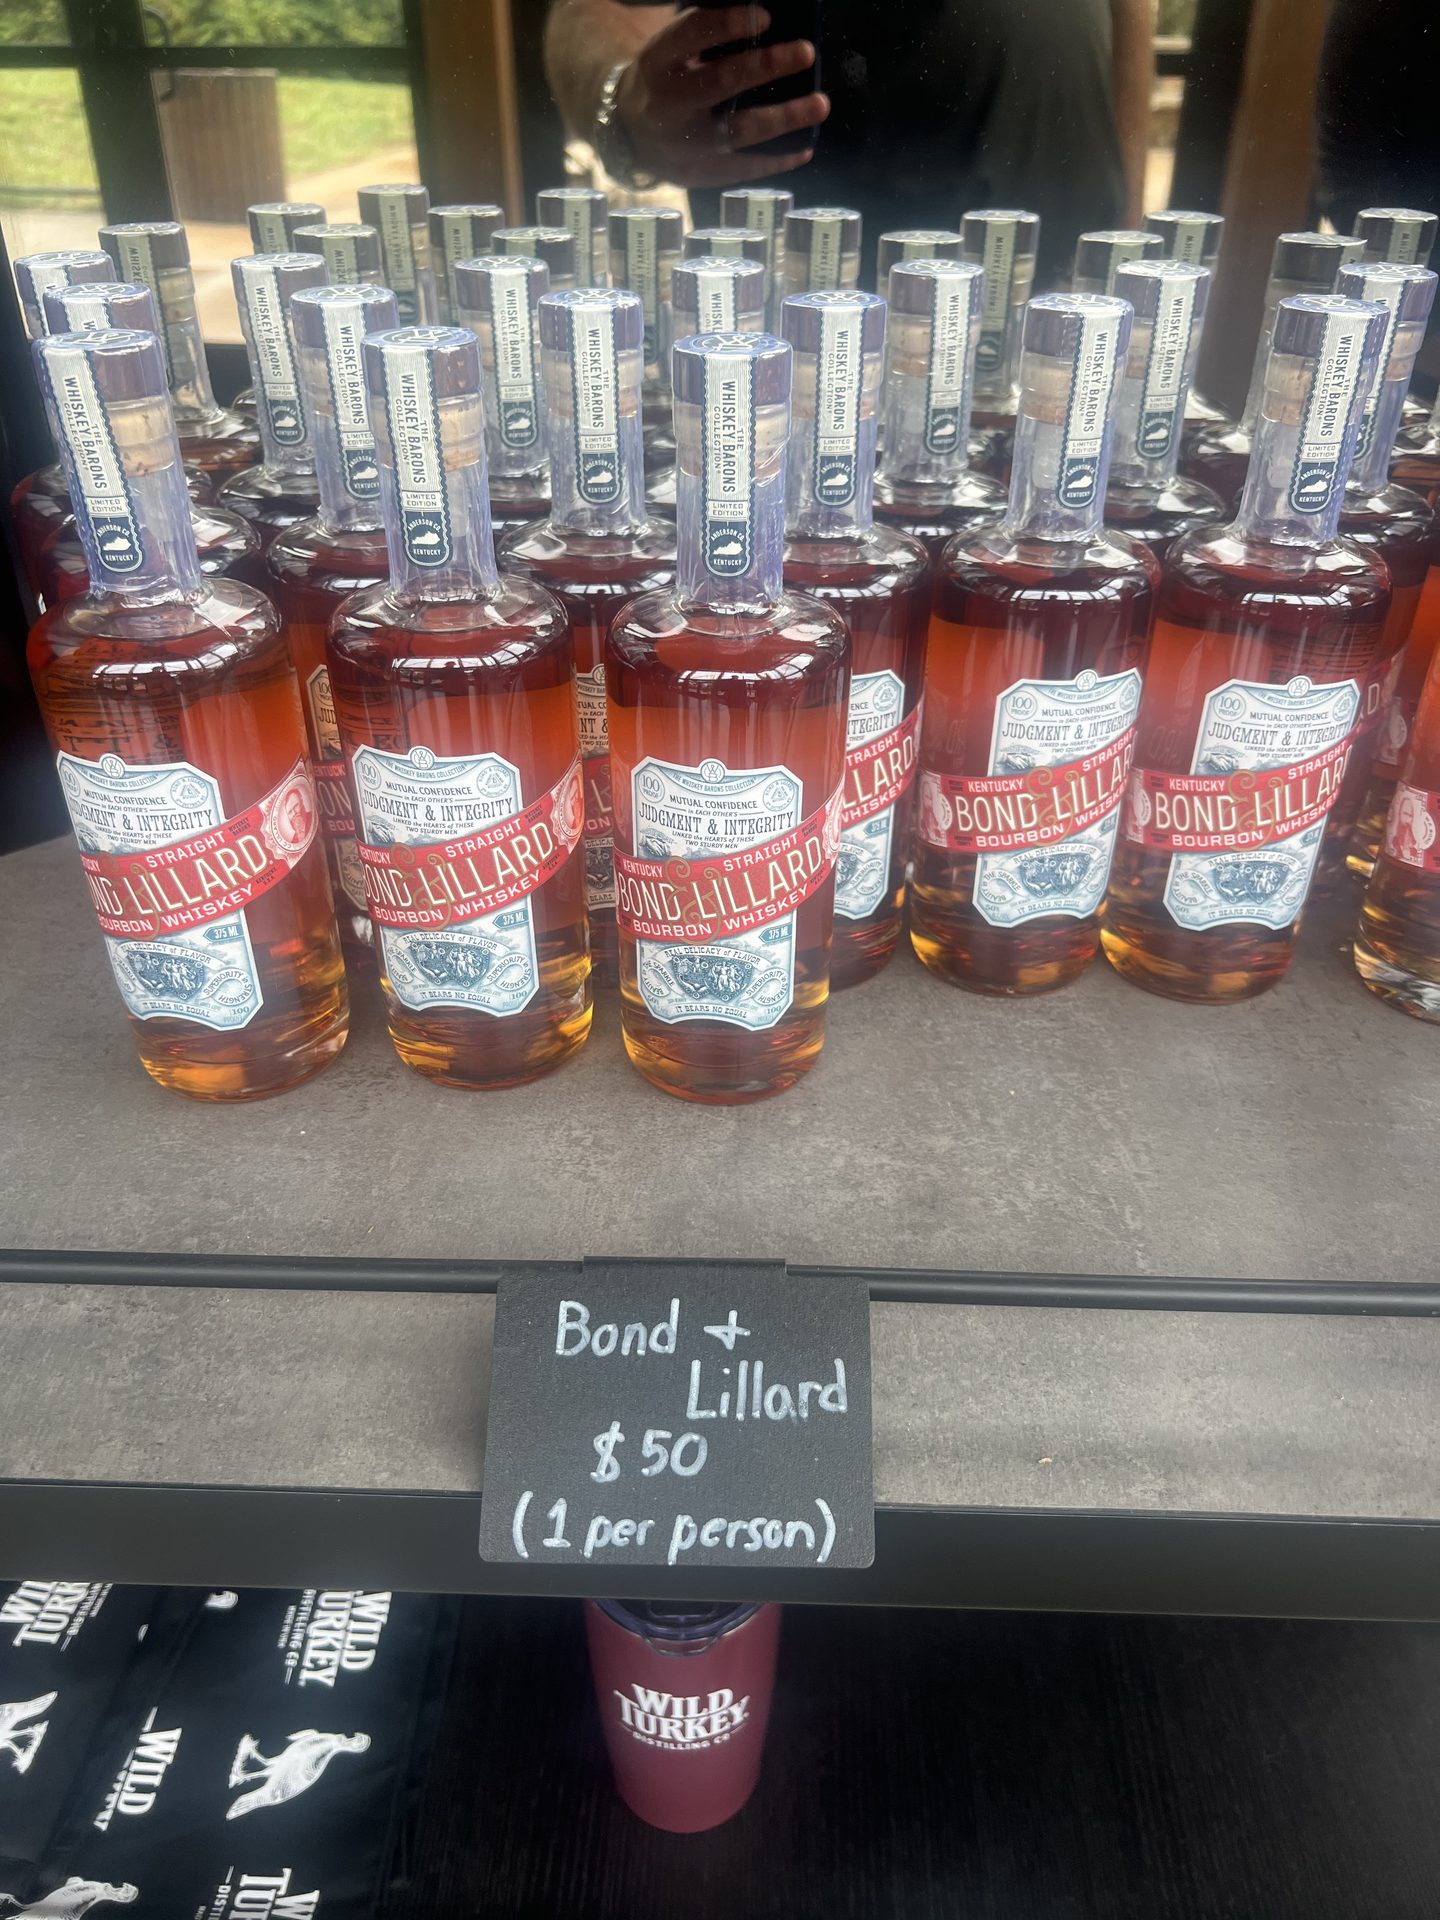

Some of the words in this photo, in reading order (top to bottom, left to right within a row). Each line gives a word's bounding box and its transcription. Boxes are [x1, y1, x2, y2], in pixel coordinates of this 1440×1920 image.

[506, 289, 518, 335] WHISKEY
[1169, 297, 1184, 346] WHISKEY
[341, 326, 359, 379] WHISKEY
[510, 340, 521, 379] BARONS
[588, 328, 602, 381] WHISKEY
[836, 330, 849, 382] WHISKEY
[1089, 332, 1108, 386] WHISKEY
[1160, 350, 1177, 389] BARONS
[1331, 335, 1353, 390] WHISKEY
[348, 381, 365, 425] BARONS
[401, 374, 419, 435] WHISKEY
[1341, 377, 1351, 397] THE
[591, 385, 604, 428] BARONS
[722, 381, 736, 442] WHISKEY
[832, 386, 845, 431] BARONS
[1083, 389, 1099, 433] BARONS
[1320, 392, 1341, 438] BARONS
[64, 377, 90, 435] WHISKEY
[82, 440, 107, 489] BARONS
[92, 424, 103, 445] THE
[736, 428, 744, 450] THE
[409, 438, 426, 484] BARONS
[722, 445, 736, 494] BARONS
[407, 519, 433, 531] ANDERSON
[710, 524, 736, 543] ANDERSON
[105, 554, 134, 562] KENTUCKY
[1042, 708, 1073, 717] MUTUAL
[1075, 702, 1116, 715] CONFIDENCE
[1219, 697, 1240, 710] 100
[1250, 712, 1282, 722] MUTUAL
[1284, 712, 1329, 721] CONFIDENCE
[846, 730, 899, 766] TRAIGHT
[1002, 722, 1071, 741] JUDGMENT
[1073, 725, 1083, 739] &
[1207, 722, 1276, 746] JUDGMENT
[1281, 731, 1291, 745] &
[641, 774, 660, 792] 100
[968, 778, 1024, 793] KENTUCKY
[1169, 778, 1225, 792] KENTUCKY
[1288, 741, 1346, 780] STRAIGHT
[84, 789, 112, 804] MUTUAL
[113, 795, 167, 805] CONFIDENCE
[363, 789, 418, 820] JUDGMENT
[425, 807, 436, 822] &
[441, 797, 513, 822] INTEGRITY
[386, 781, 415, 794] MUTUAL
[416, 786, 472, 796] CONFIDENCE
[670, 795, 703, 808] MUTUAL
[705, 800, 758, 809] CONFIDENCE
[122, 816, 134, 831] &
[137, 809, 213, 831] INTEGRITY
[639, 802, 702, 833] JUDGMENT
[707, 819, 719, 835] &
[724, 812, 793, 835] INTEGRITY
[955, 795, 1037, 832] BOND
[1156, 793, 1237, 832] BOND
[146, 831, 226, 869] STRAIGHT
[445, 819, 522, 857] STRAIGHT
[672, 831, 692, 840] LINKED
[976, 823, 1064, 847] BOURBON
[1172, 829, 1264, 847] BOURBON
[623, 859, 664, 878] KENTUCKY
[723, 832, 799, 872] STRAIGHT
[162, 885, 253, 928] WHISKEY
[375, 906, 444, 923] BOURBON
[453, 870, 541, 917] WHISKEY
[618, 875, 681, 921] BOND
[634, 919, 712, 937] BOURBON
[724, 883, 808, 931] WHISKEY
[214, 928, 228, 939] 375
[228, 928, 239, 937] ML
[503, 914, 515, 926] 375
[515, 912, 525, 922] ML
[768, 928, 780, 939] 375
[780, 927, 789, 937] ML
[420, 934, 454, 942] DELICACY
[469, 938, 497, 950] FLAVOR
[665, 950, 681, 958] REAL
[733, 951, 760, 964] FLAVOR
[747, 971, 784, 996] SUPERIORITY
[684, 1005, 710, 1013] BEARS
[725, 1008, 748, 1018] EQUAL
[555, 1298, 679, 1356] Bond
[704, 1310, 751, 1349] +
[687, 1358, 847, 1422] Lillard
[584, 1514, 655, 1558] per
[668, 1498, 835, 1565] person)
[298, 1590, 353, 1688] URKEY
[340, 1591, 393, 1670] WILD
[631, 1683, 734, 1718] WILD
[633, 1732, 710, 1750] DISTILLING
[117, 1727, 182, 1815] WILD
